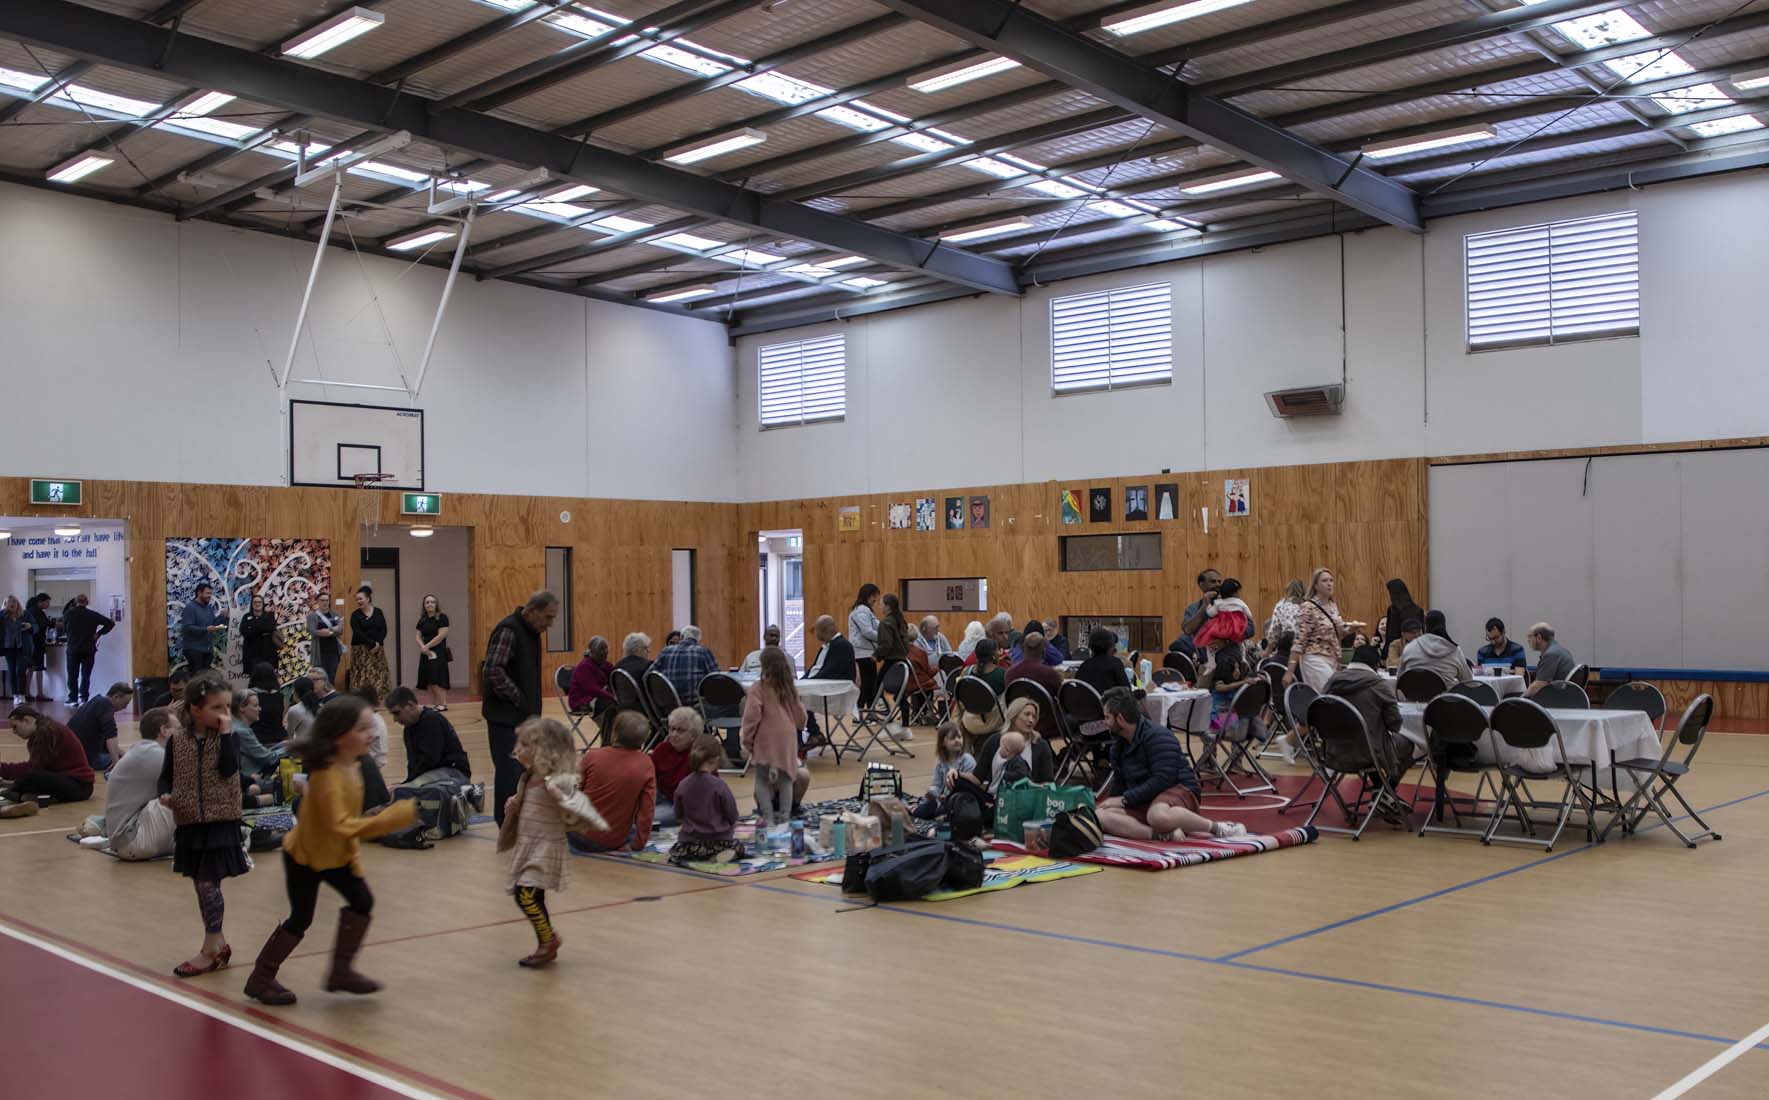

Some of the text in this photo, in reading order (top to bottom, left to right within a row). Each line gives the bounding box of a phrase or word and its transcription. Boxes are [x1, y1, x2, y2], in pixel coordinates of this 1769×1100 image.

[28, 537, 46, 545] come
[22, 549, 34, 559] and
[36, 549, 51, 559] have
[53, 548, 59, 559] it
[71, 548, 82, 558] the
